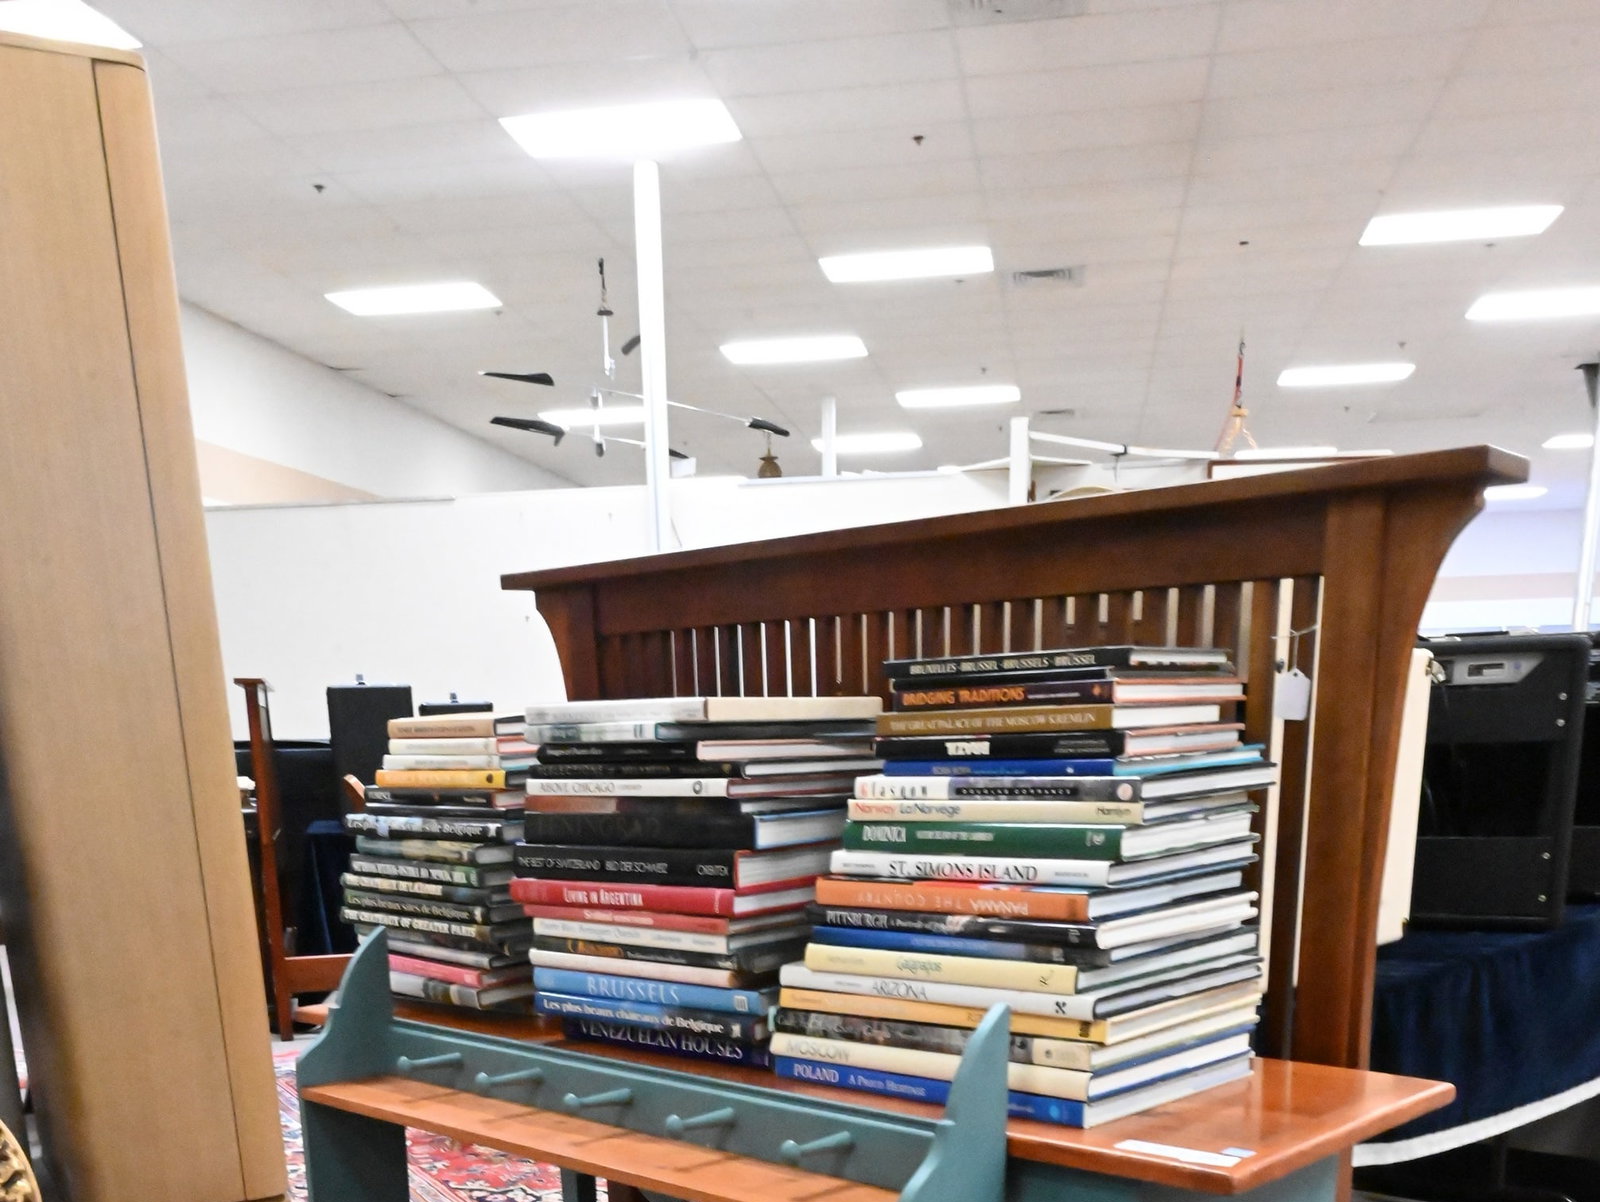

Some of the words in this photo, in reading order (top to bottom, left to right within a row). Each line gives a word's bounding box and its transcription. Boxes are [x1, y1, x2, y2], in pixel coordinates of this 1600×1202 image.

[903, 691, 955, 706] BRIDGING
[958, 687, 1025, 703] TRADITIONS
[888, 860, 911, 877] ST.
[914, 861, 975, 879] SIMONS
[978, 863, 1038, 881] ISLAND
[563, 887, 588, 904] LIVING
[600, 888, 643, 907] ARGENTINA
[826, 910, 888, 928] PITTSBURGH
[587, 976, 680, 1004] BRUSSELS
[872, 980, 928, 1000] ARIZONA
[543, 998, 560, 1009] Les
[561, 1001, 582, 1013] plus
[661, 1015, 673, 1026] de
[675, 1017, 724, 1034] Belgique
[580, 1019, 677, 1049] VENEZUELAN
[681, 1034, 743, 1059] HOUSES
[793, 1063, 840, 1083] POLAND
